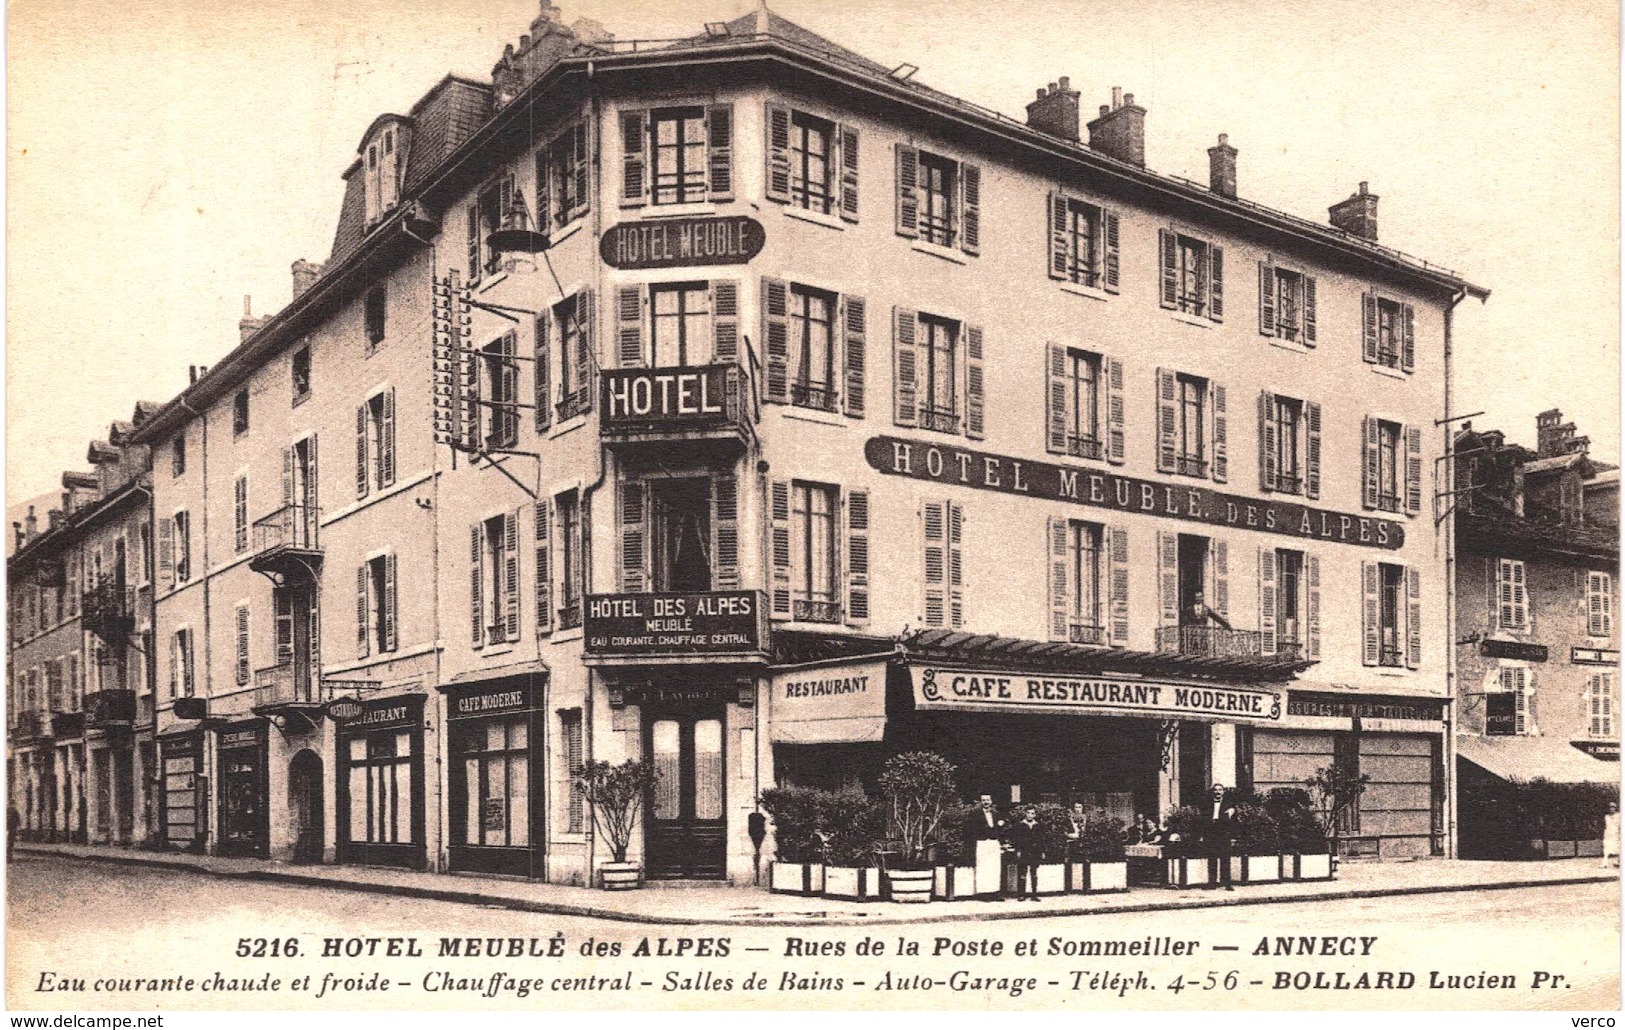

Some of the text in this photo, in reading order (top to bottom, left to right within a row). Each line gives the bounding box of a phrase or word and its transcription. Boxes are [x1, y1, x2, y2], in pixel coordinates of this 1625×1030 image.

[617, 221, 749, 263] HOTEL MEUBLE
[609, 373, 722, 417] HOTEL
[1227, 502, 1276, 528] DES
[1299, 508, 1389, 545] ALPES
[590, 597, 751, 618] HÔTEL DES ALPES
[646, 616, 693, 632] MEUBLÉ
[591, 637, 608, 647] EAU
[658, 635, 707, 646] CHAUFFAGE
[711, 634, 750, 645] CENTRAL
[786, 676, 869, 698] RESTAURANT
[951, 676, 1263, 713] CAFE RESTAURANT MODERNE
[459, 690, 523, 712] CAFE MODERNE
[344, 707, 408, 727] TAURANT
